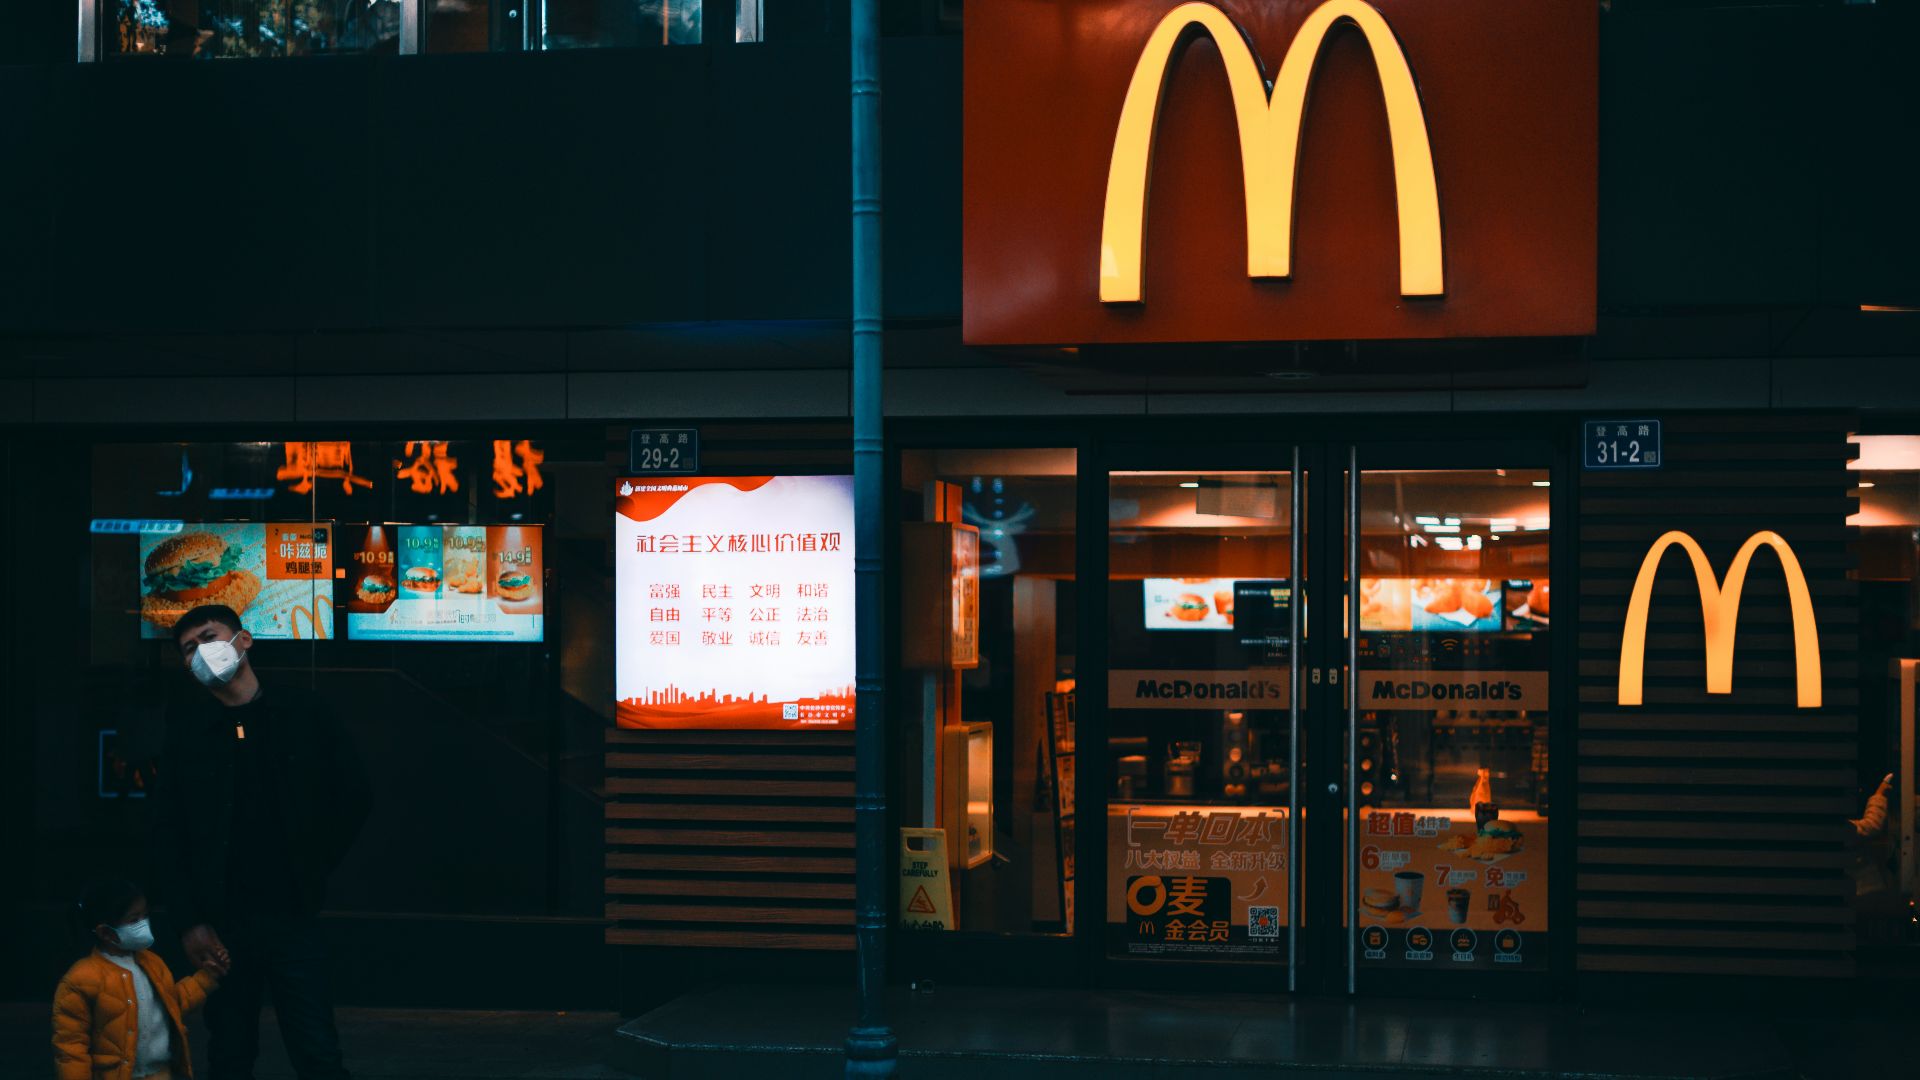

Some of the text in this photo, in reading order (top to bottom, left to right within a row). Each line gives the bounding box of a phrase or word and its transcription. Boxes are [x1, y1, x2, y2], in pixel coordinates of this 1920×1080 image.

[1100, 1, 1446, 304] M
[641, 433, 688, 444] 登高路
[1595, 424, 1650, 437] 登高路
[641, 447, 679, 469] 29-2
[1597, 440, 1640, 463] 31-2
[636, 532, 841, 553] 社会主义核心价值观
[649, 583, 828, 599] 富强 民主 文明 和谐
[649, 607, 828, 622] 自由 平等 公正 法治
[1619, 530, 1822, 708] M
[649, 631, 828, 646] 爱国 敬业 诚信 友善
[1135, 679, 1281, 699] McDonald's
[1372, 680, 1522, 700] McDonald's
[1131, 811, 1277, 845] 一单回本
[1126, 850, 1286, 872] 八大权益 全新升级
[903, 869, 938, 877] CAREFULLY
[1164, 918, 1230, 942] 金会员
